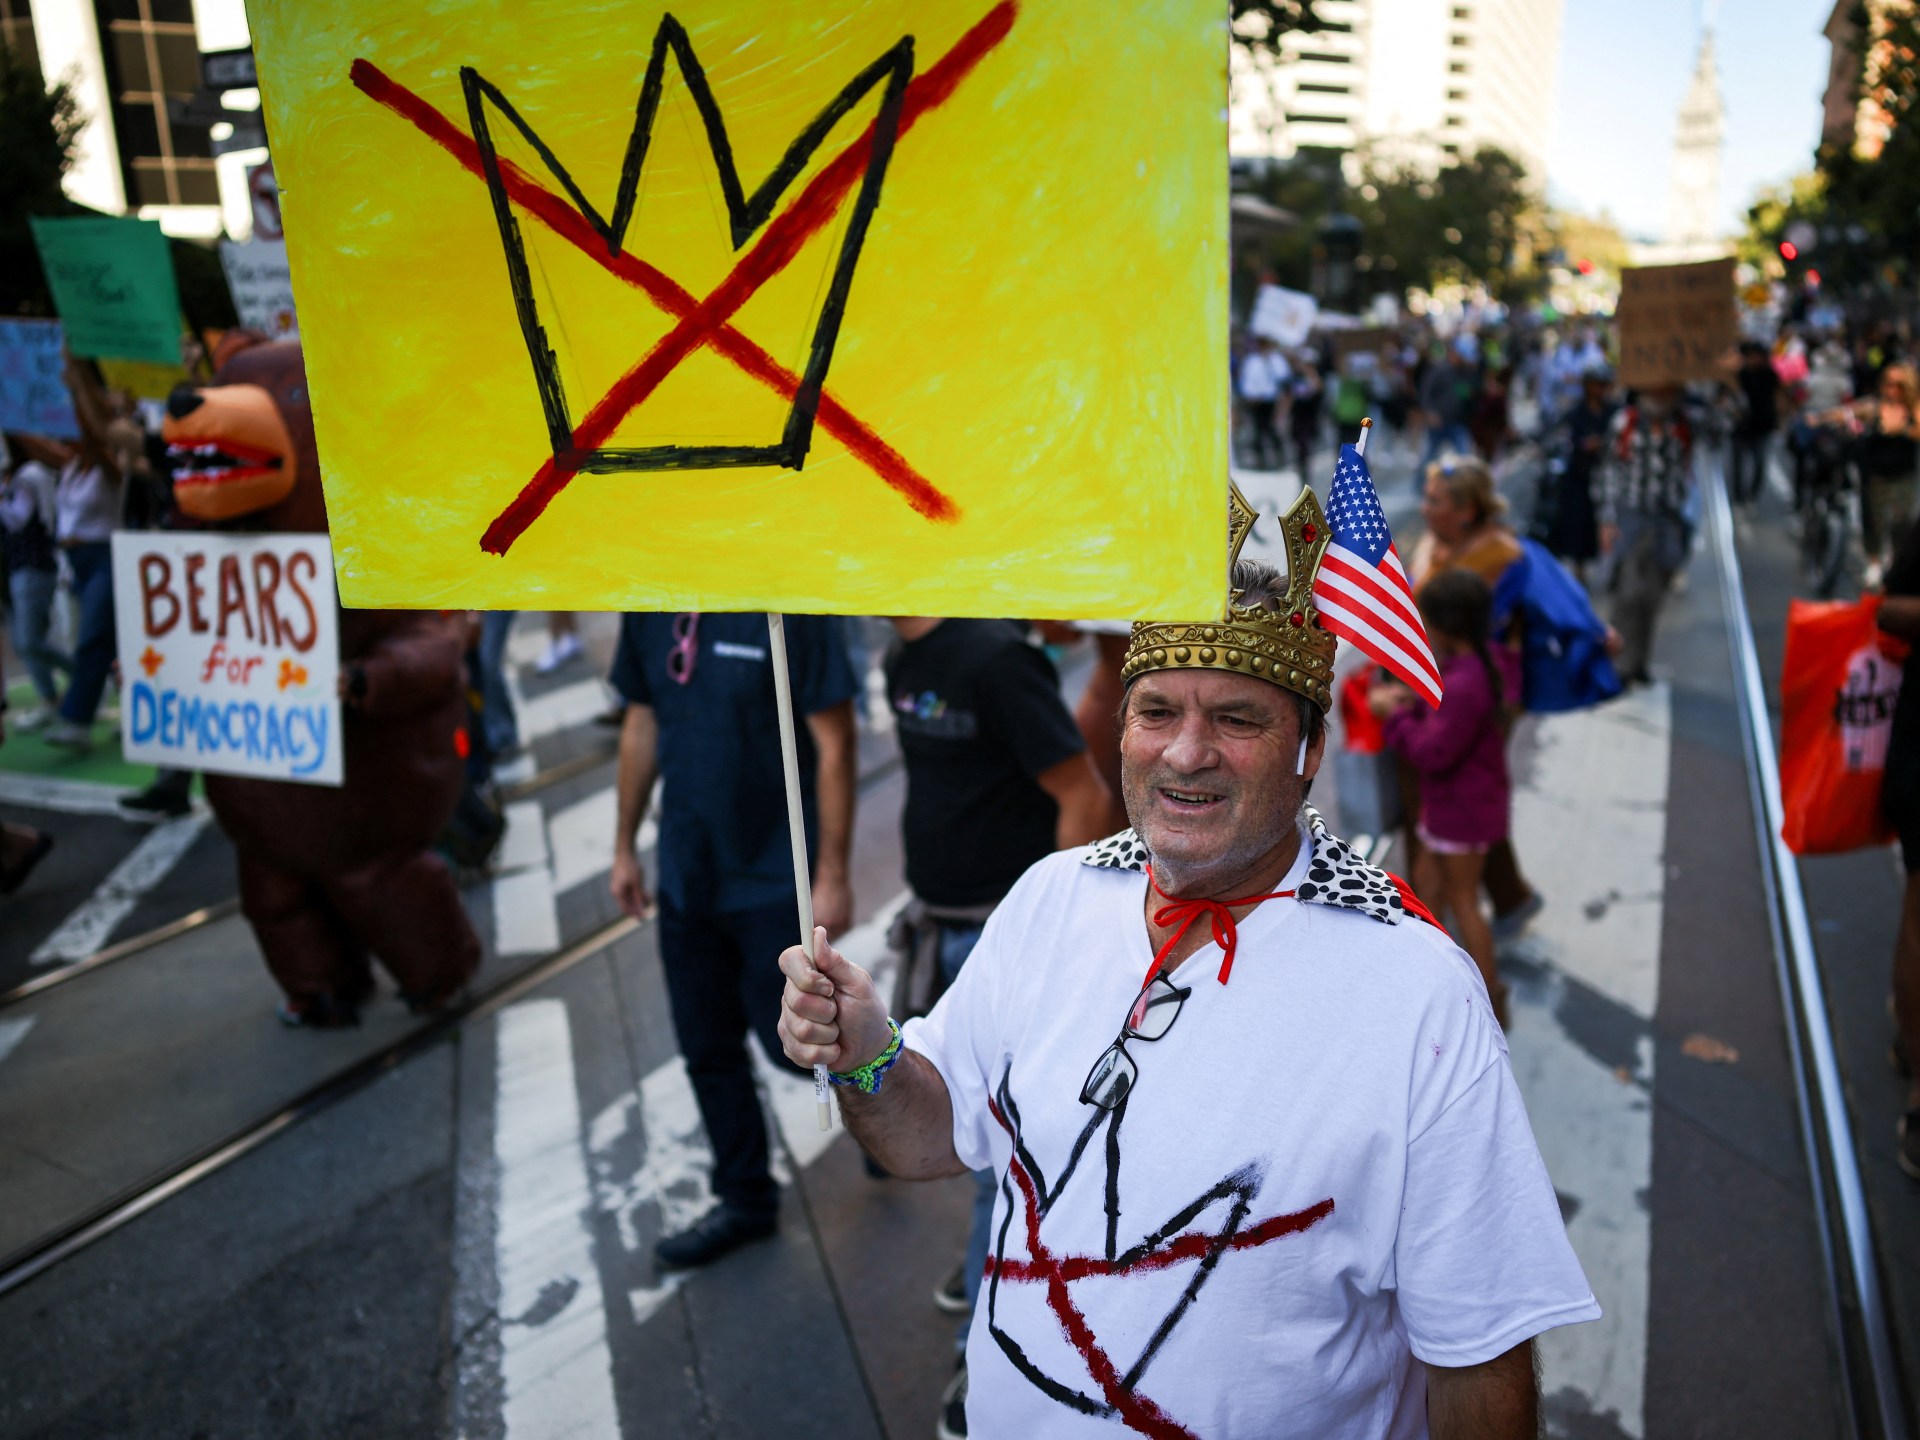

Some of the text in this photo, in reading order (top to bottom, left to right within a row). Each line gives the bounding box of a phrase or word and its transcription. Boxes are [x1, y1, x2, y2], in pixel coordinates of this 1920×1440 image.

[140, 551, 317, 652] BEARS
[201, 642, 263, 685] for
[131, 682, 328, 775] DEMOCRACY
